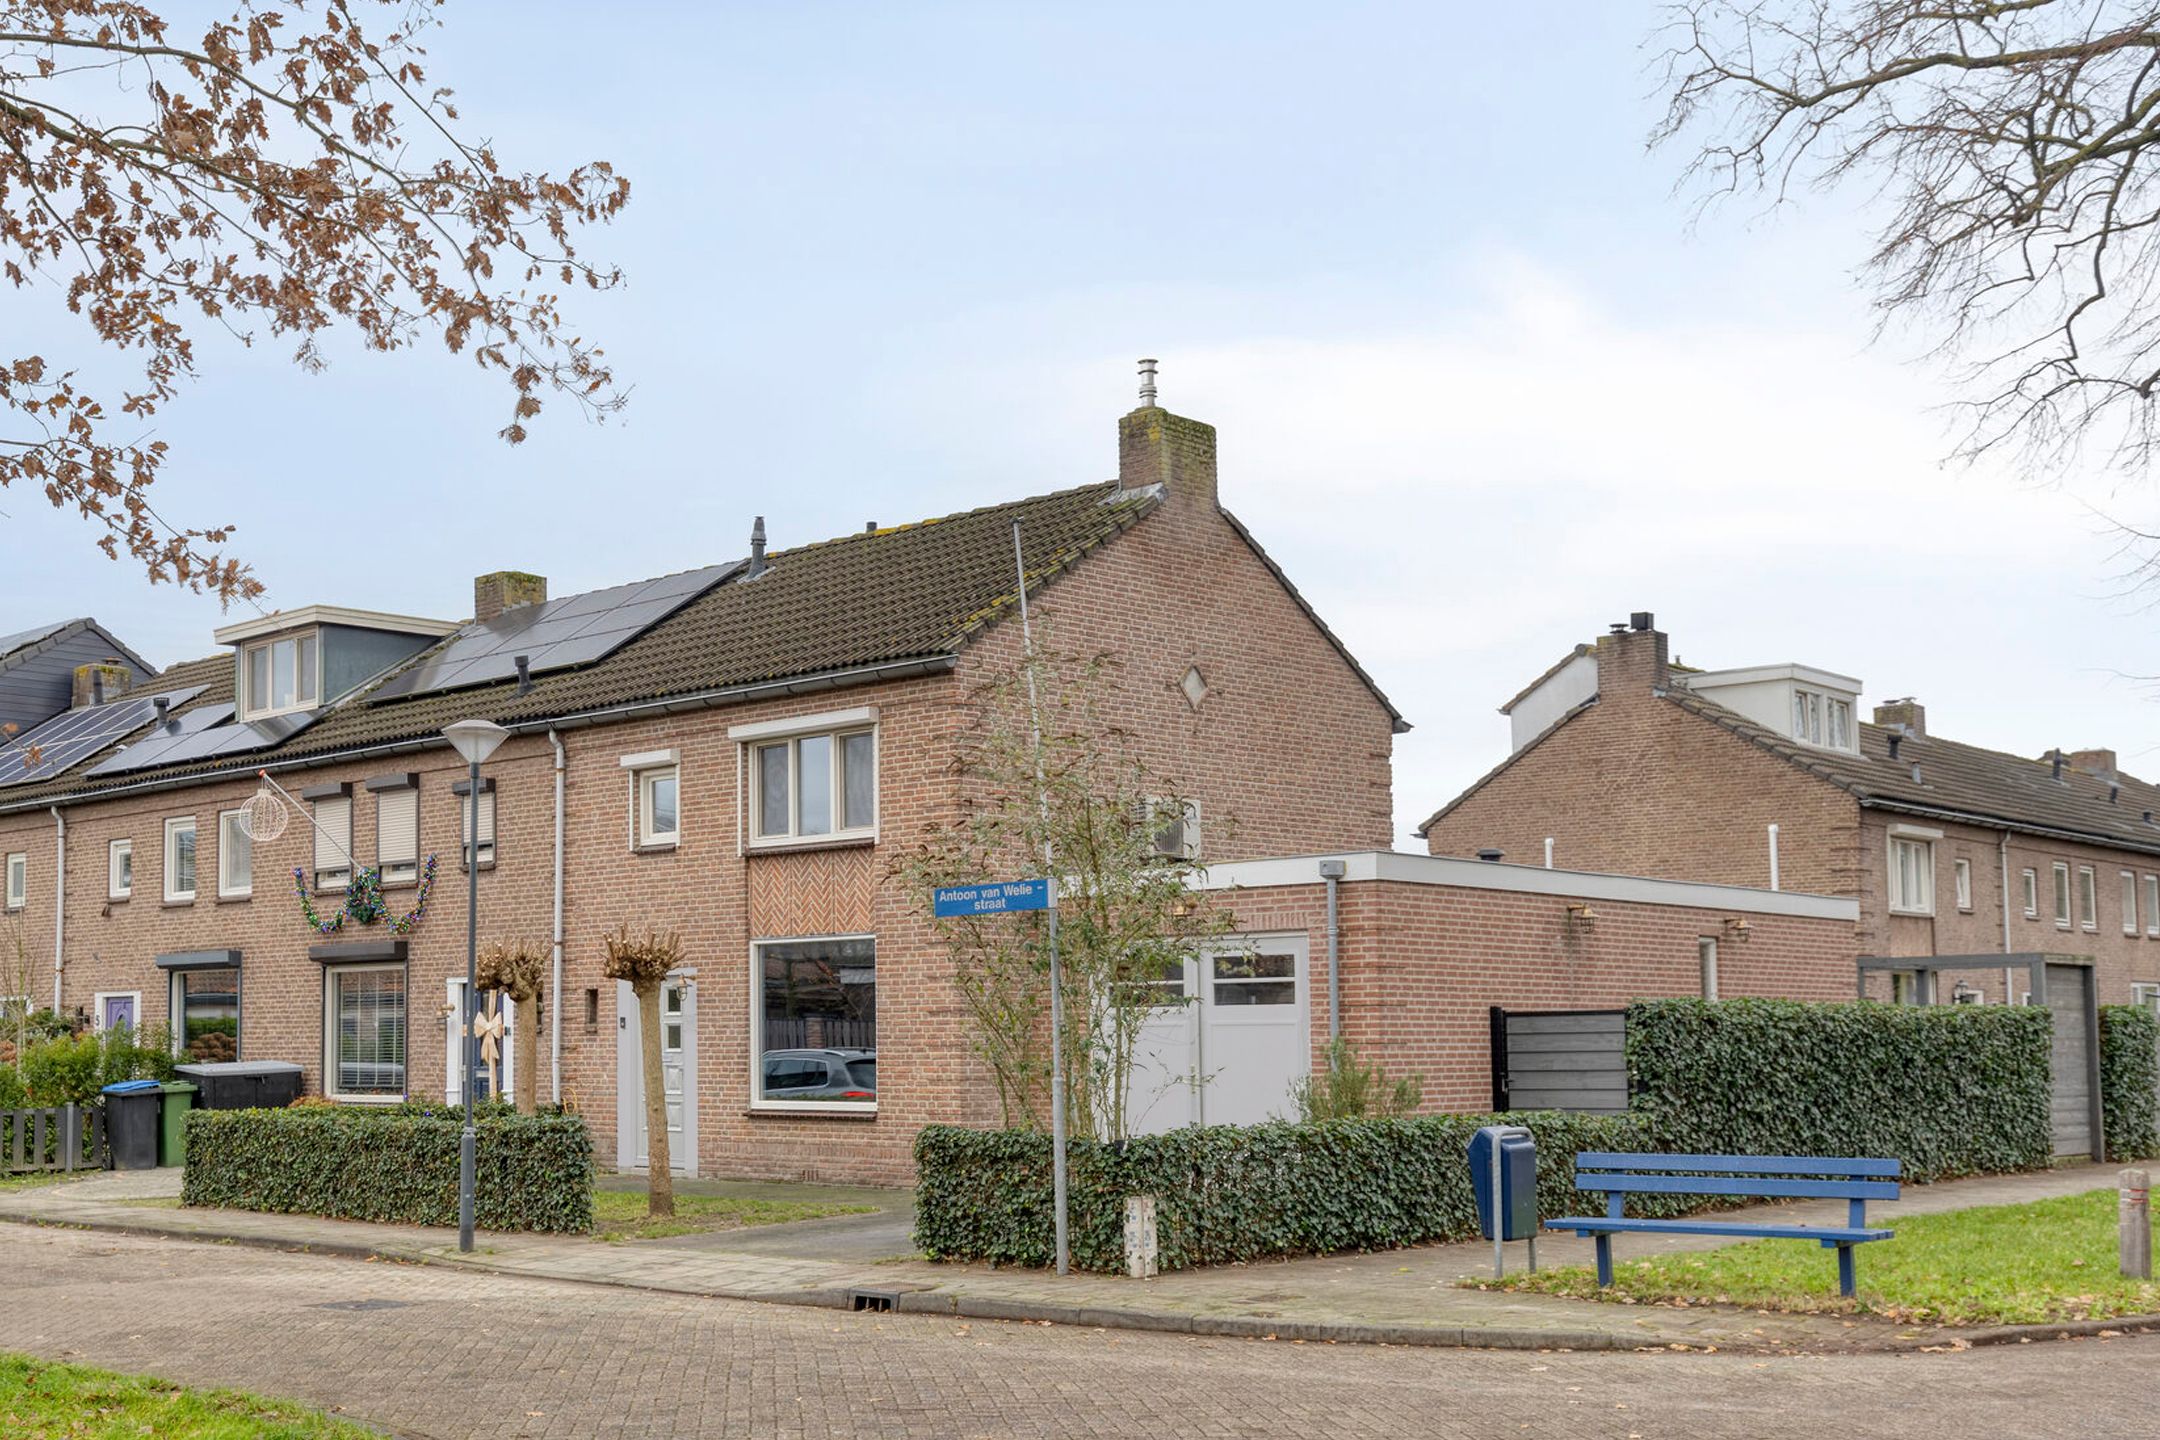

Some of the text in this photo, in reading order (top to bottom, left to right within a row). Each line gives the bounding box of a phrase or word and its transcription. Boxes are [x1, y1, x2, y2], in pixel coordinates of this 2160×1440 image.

[939, 889, 977, 902] Antoon
[981, 888, 1000, 898] van
[1003, 884, 1032, 896] Welie
[974, 898, 1006, 910] straat
[95, 1014, 100, 1026] 5
